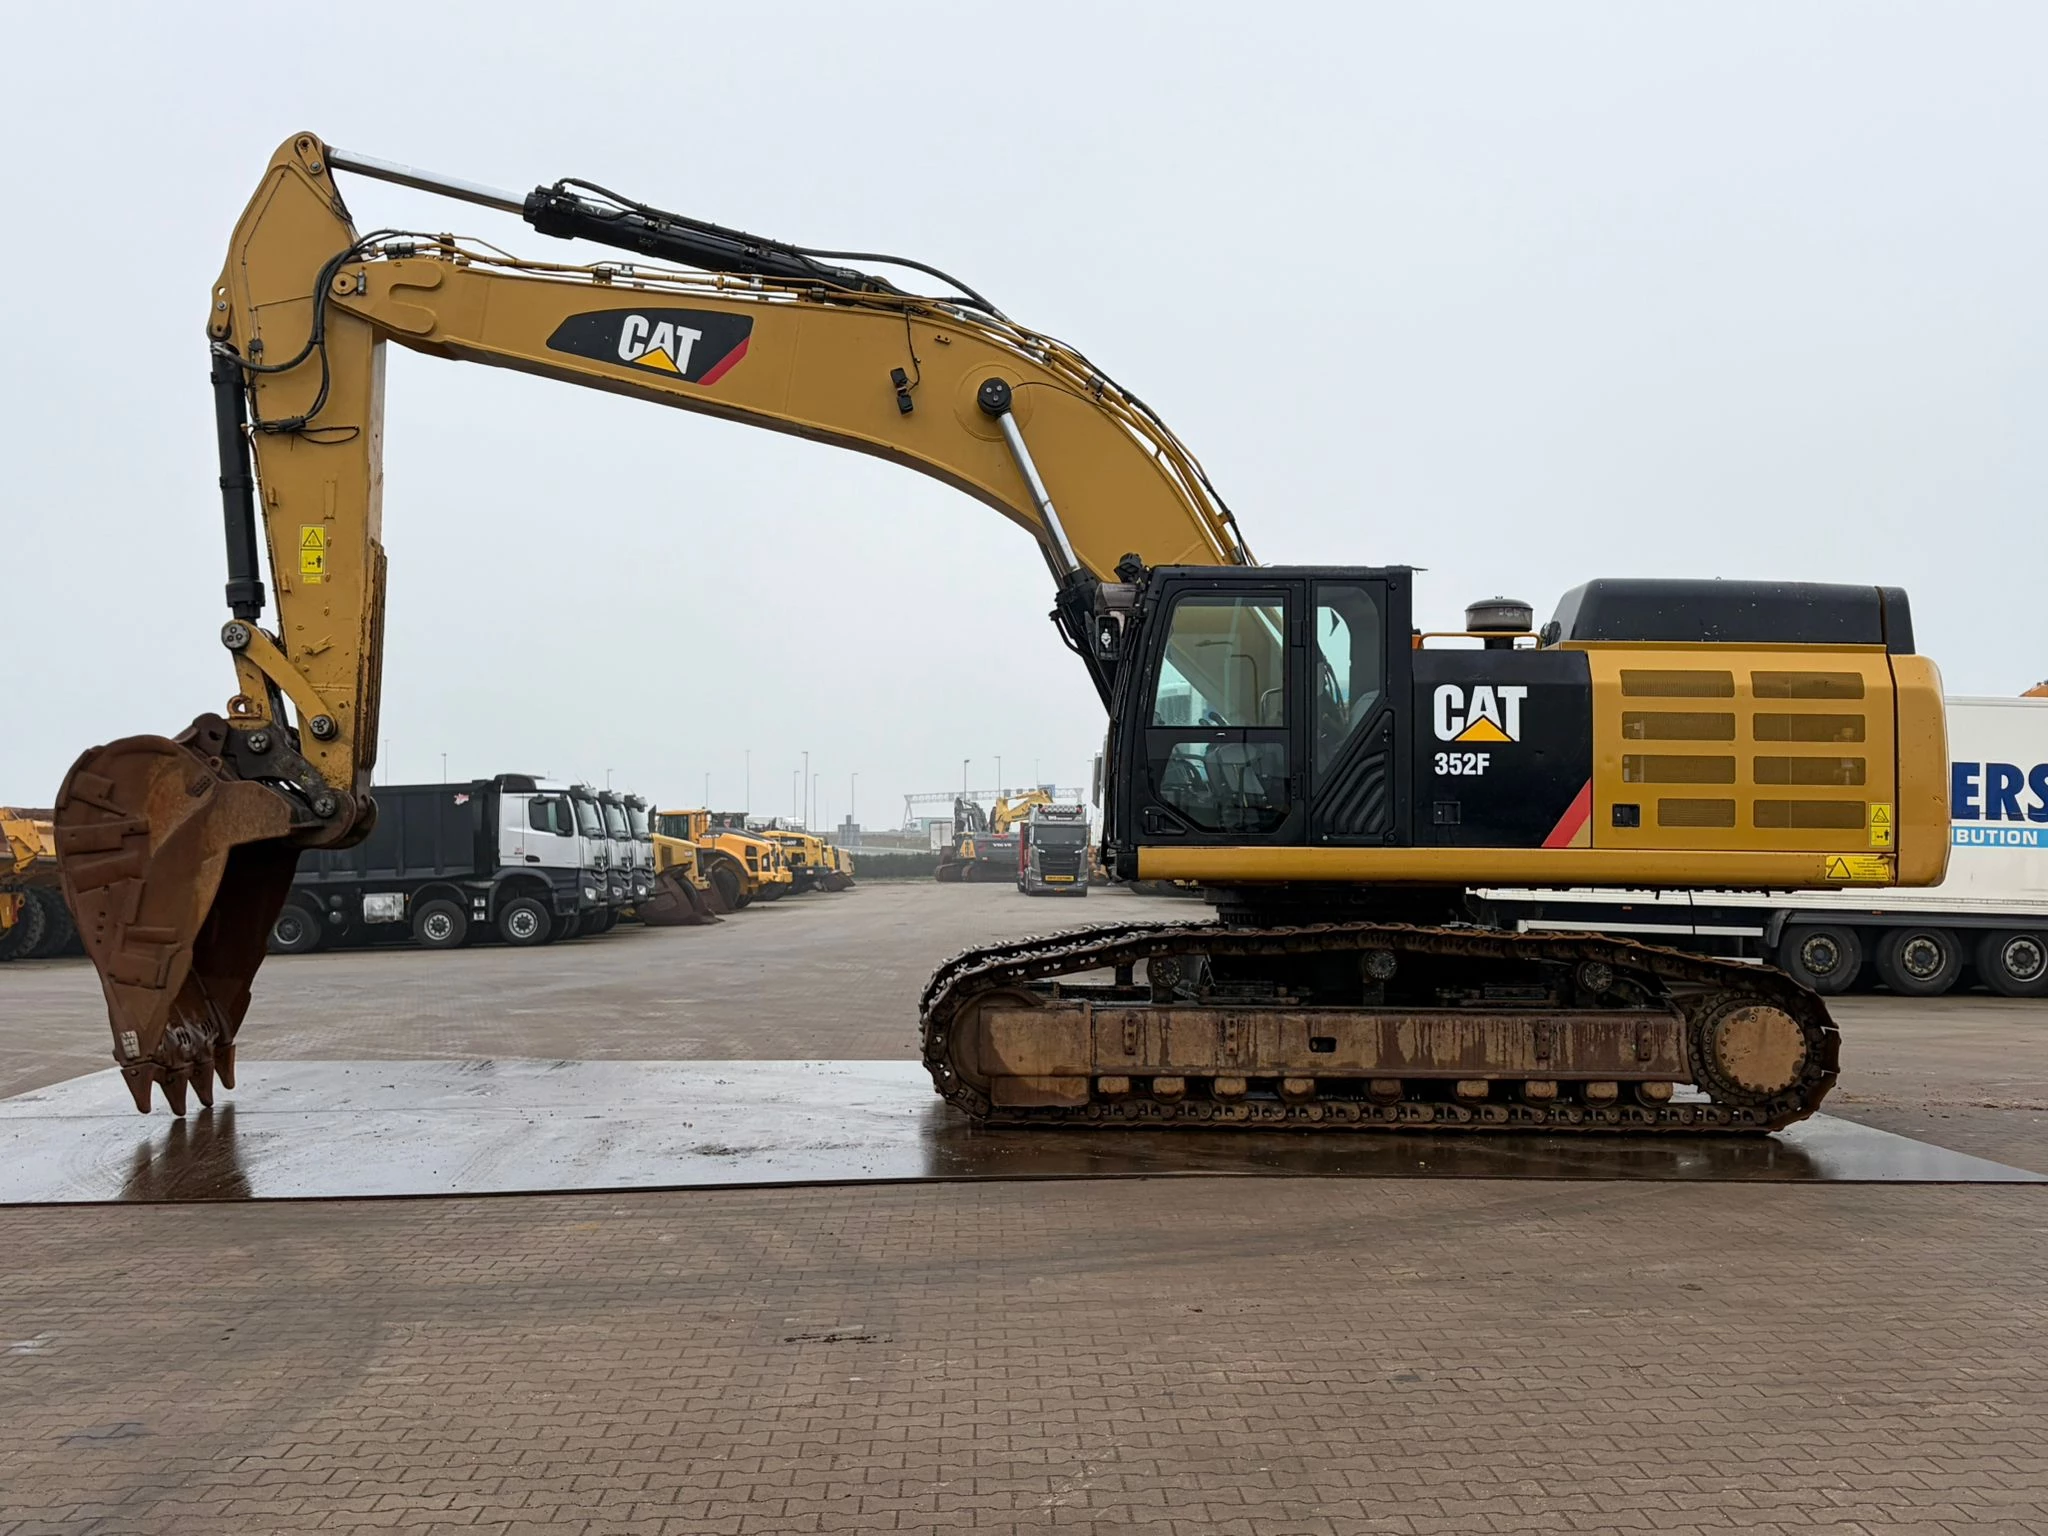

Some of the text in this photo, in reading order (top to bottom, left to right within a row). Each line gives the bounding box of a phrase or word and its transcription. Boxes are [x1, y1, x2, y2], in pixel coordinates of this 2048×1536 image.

[618, 314, 702, 375] CAT
[1433, 684, 1528, 742] CAT
[1434, 752, 1490, 775] 352F
[1951, 762, 2048, 823] ERS
